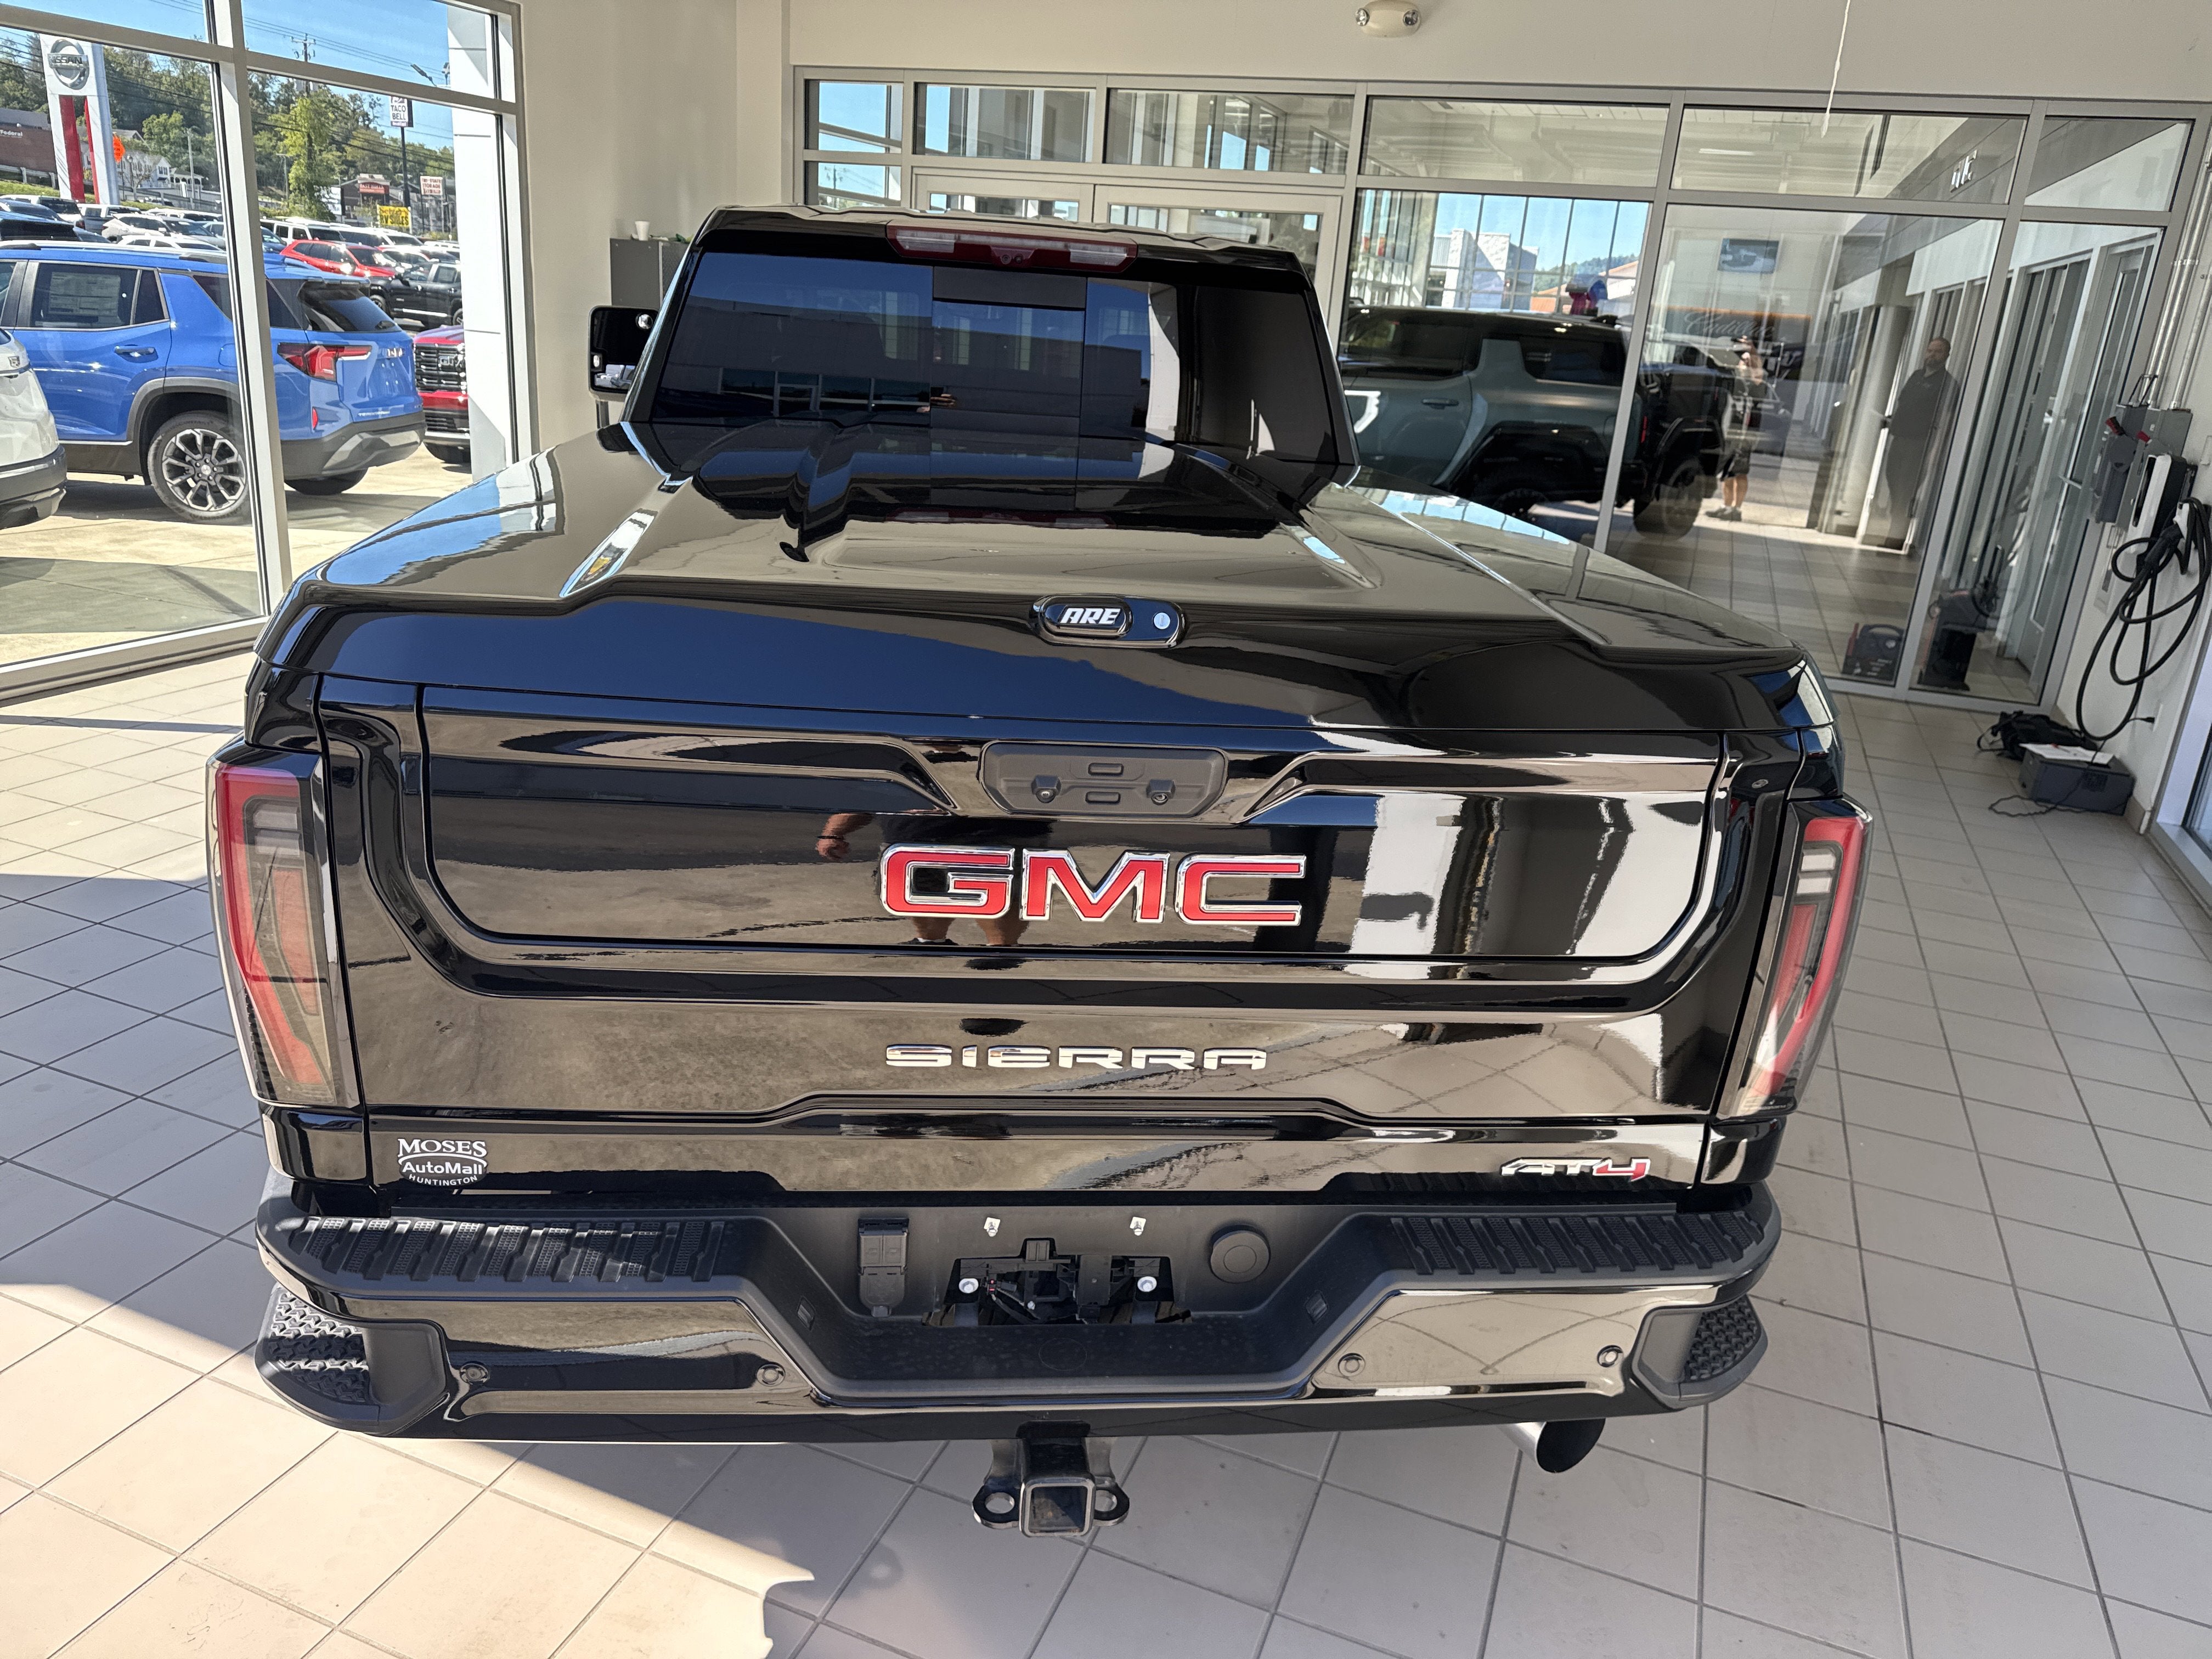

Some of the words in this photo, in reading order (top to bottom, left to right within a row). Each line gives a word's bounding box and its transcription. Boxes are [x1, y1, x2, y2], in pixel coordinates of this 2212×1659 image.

[380, 215, 388, 224] RV
[1059, 607, 1121, 625] ARE
[880, 843, 1306, 927] GMC
[885, 1044, 1267, 1070] SIERRA
[397, 1138, 488, 1158] MOSES
[402, 1161, 483, 1175] AutoMall
[1500, 1158, 1651, 1182] AT4
[409, 1173, 478, 1186] HUNTINGTON
